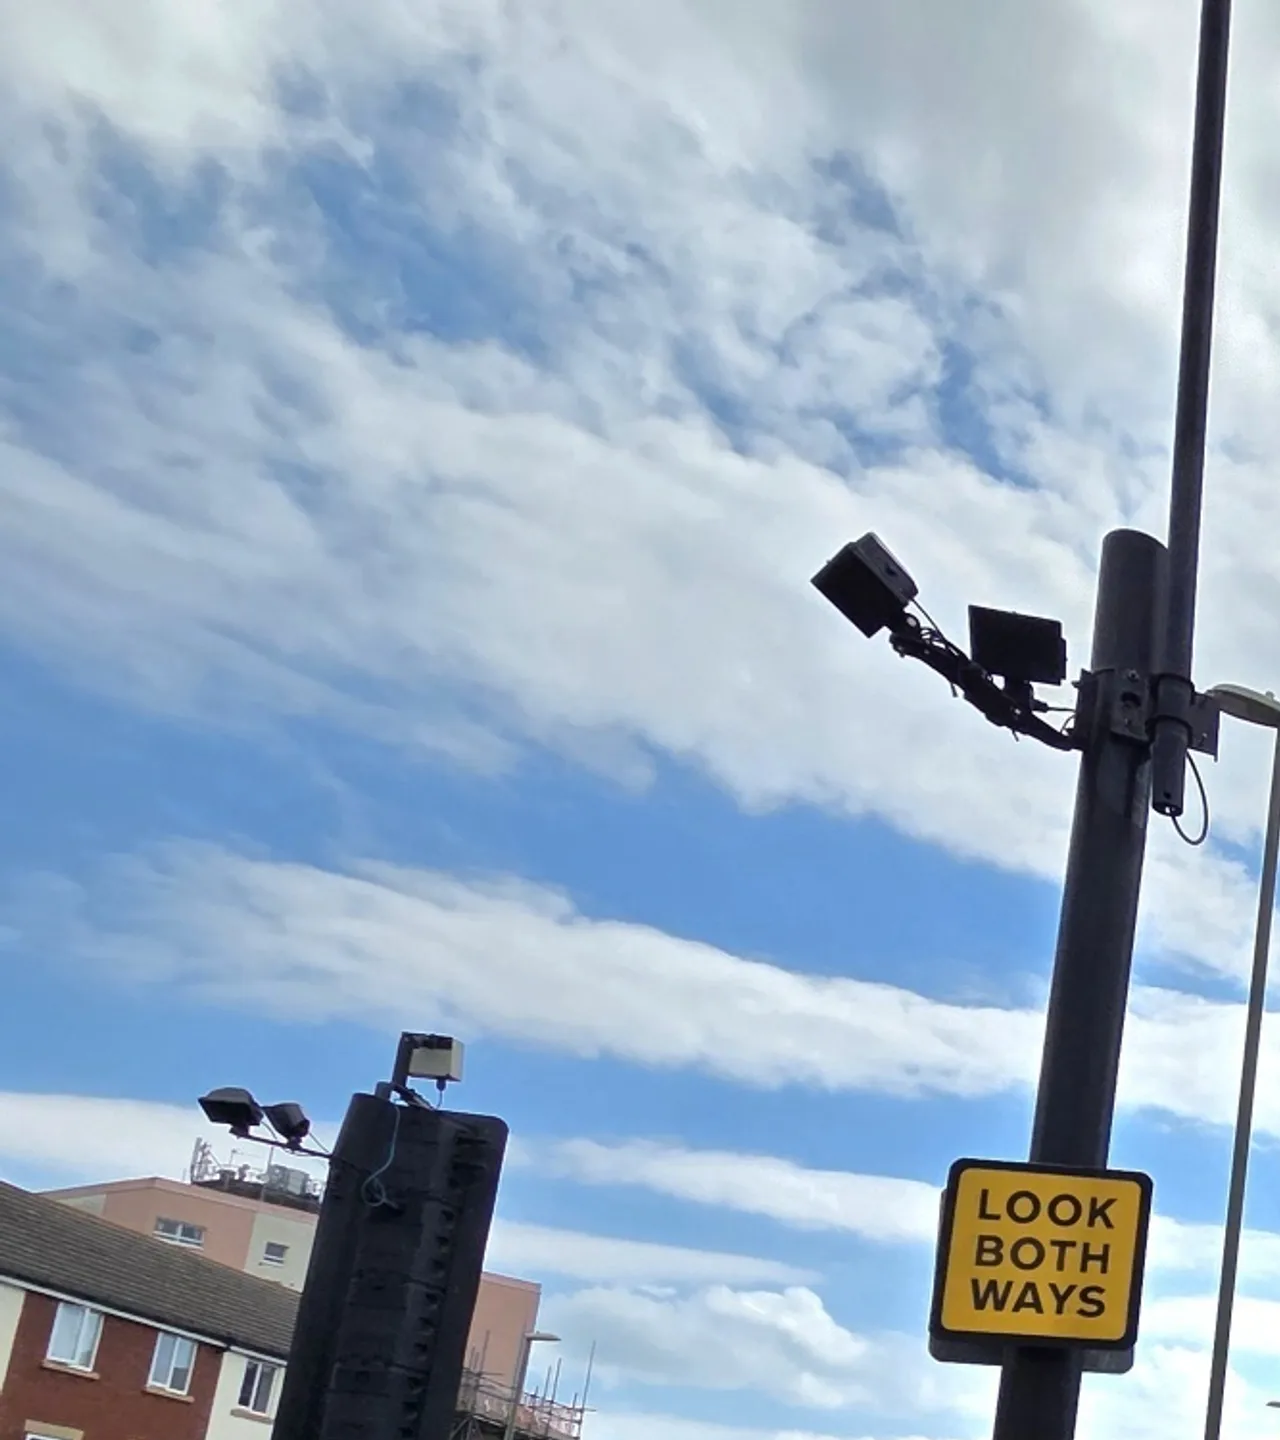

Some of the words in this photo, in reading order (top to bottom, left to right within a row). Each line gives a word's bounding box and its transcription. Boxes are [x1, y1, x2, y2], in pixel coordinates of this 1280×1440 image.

[977, 1188, 1118, 1230] LOOK
[974, 1234, 1111, 1275] BOTH
[970, 1277, 1106, 1318] WAYS
